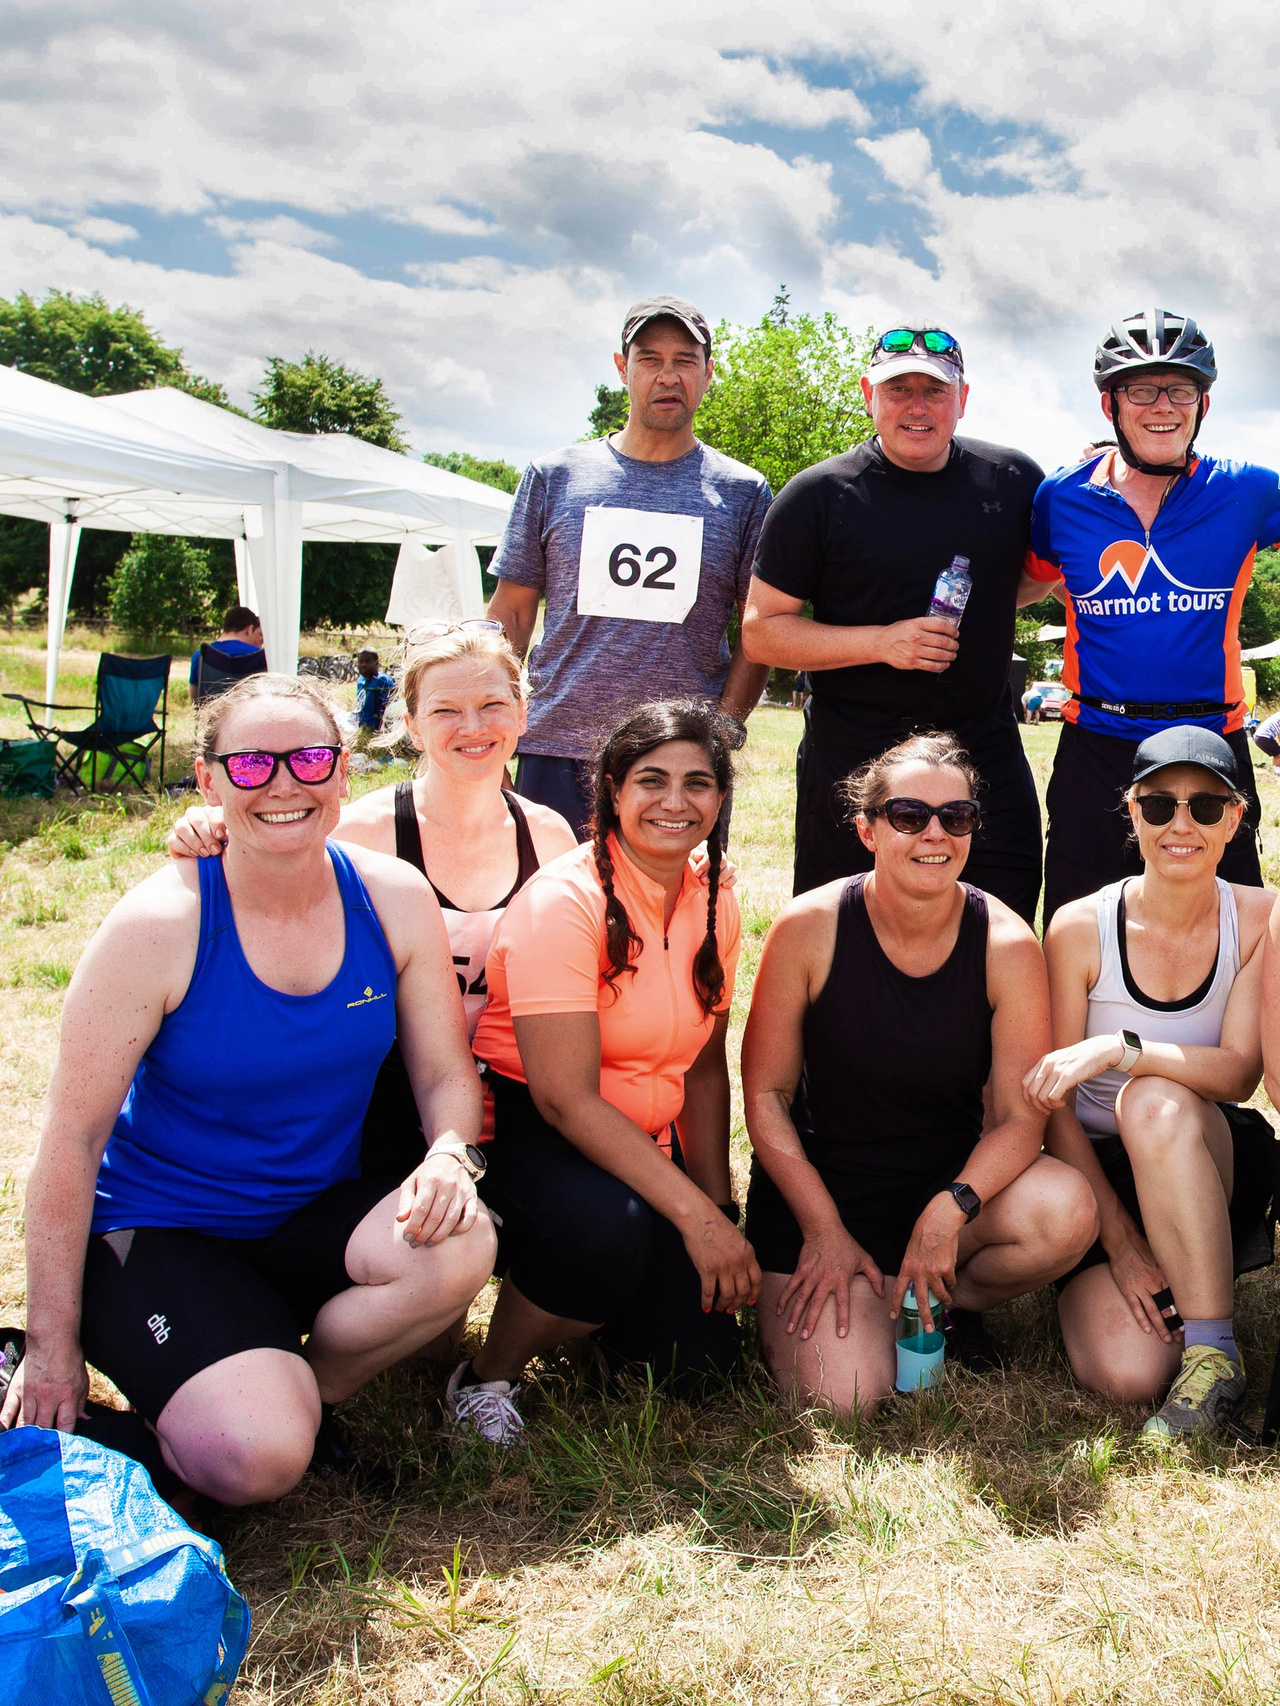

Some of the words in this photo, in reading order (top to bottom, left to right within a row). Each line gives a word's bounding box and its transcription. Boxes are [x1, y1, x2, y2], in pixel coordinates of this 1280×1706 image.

[609, 543, 677, 590] 62
[1076, 592, 1162, 616] marmot
[1167, 591, 1225, 612] tours
[147, 1313, 171, 1345] dhb
